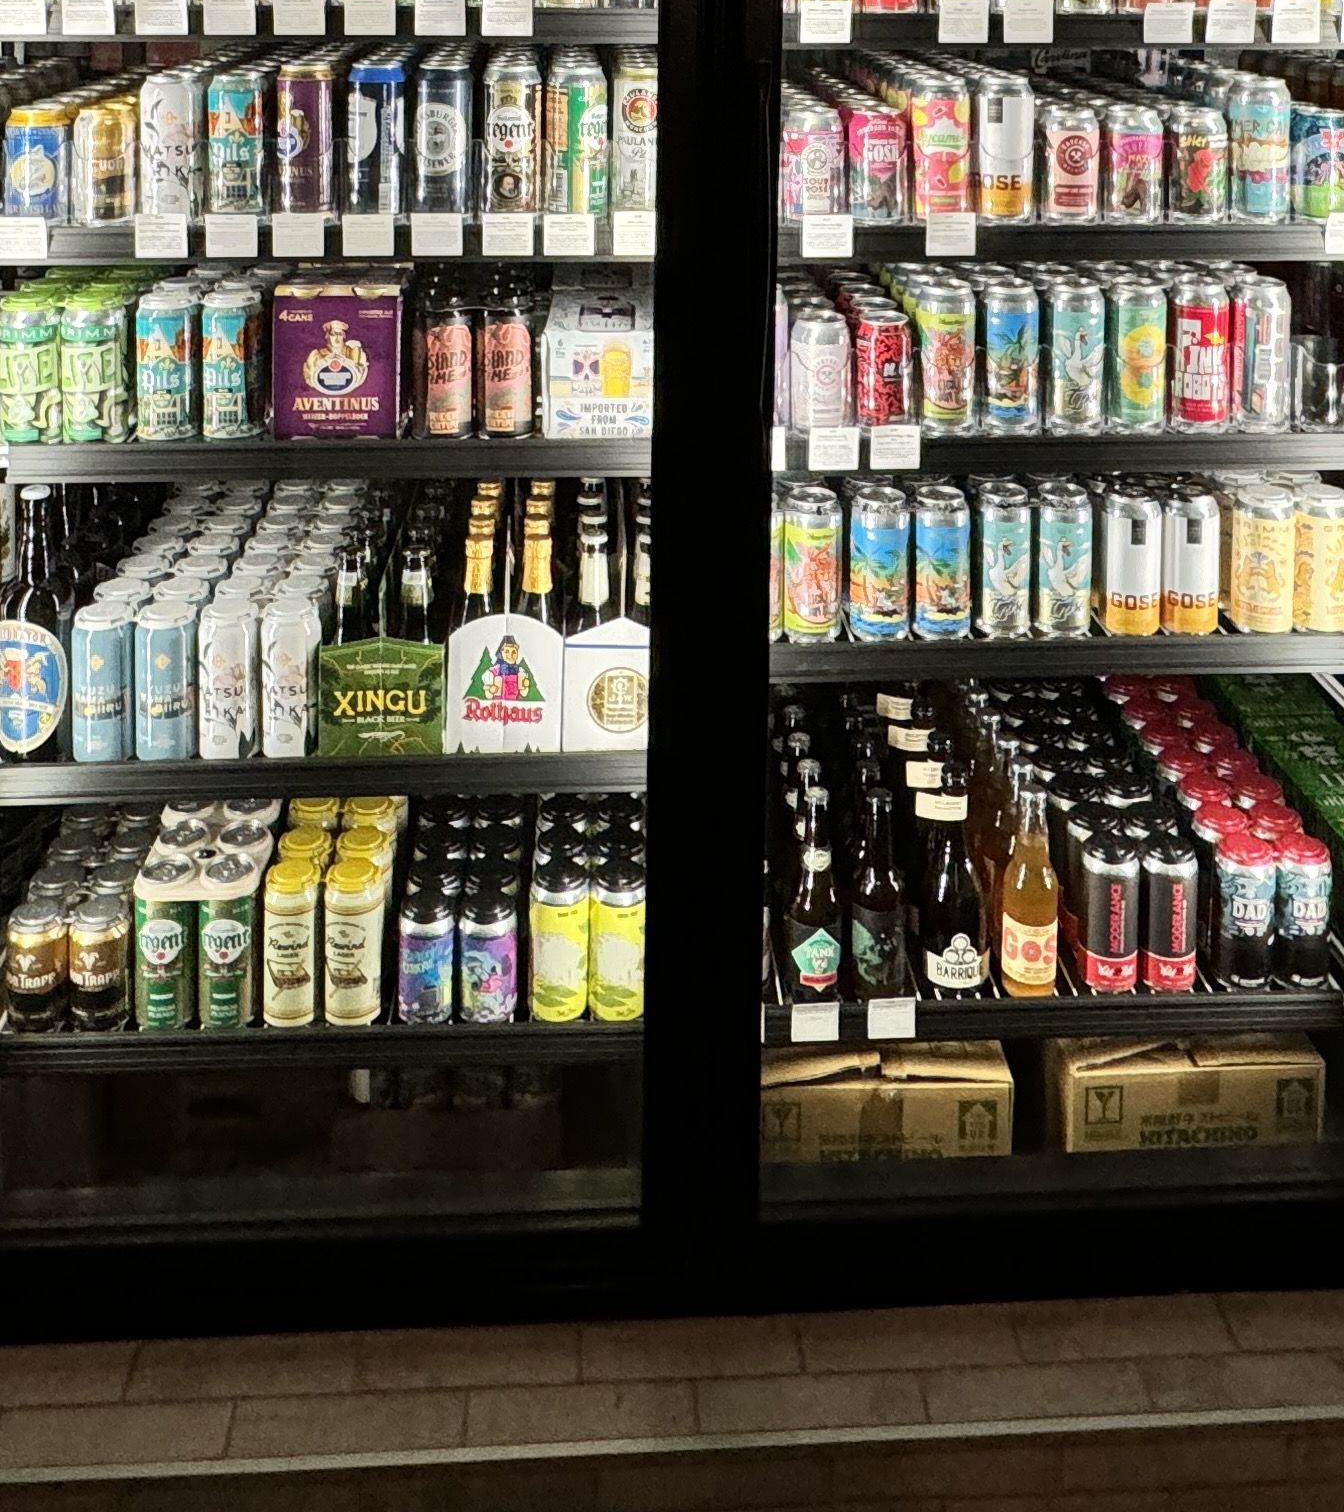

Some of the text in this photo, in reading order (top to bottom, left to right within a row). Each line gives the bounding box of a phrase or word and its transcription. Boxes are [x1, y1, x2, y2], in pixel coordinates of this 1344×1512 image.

[213, 141, 249, 162] Pils
[289, 313, 314, 322] CANS
[141, 369, 181, 390] Pils
[204, 368, 242, 387] Pils
[292, 396, 380, 411] AVENTINUS
[579, 404, 628, 415] IMPORTED
[591, 415, 617, 425] FROM
[579, 426, 629, 437] SAN DIEGO
[1110, 592, 1159, 610] GOSE
[1167, 590, 1216, 610] GOSE
[333, 689, 427, 717] XINGU
[463, 698, 543, 725] Rothaus
[356, 716, 384, 724] BLACK
[1232, 898, 1268, 919] DAD
[1293, 898, 1328, 919] DAD
[325, 936, 366, 952] Rewind
